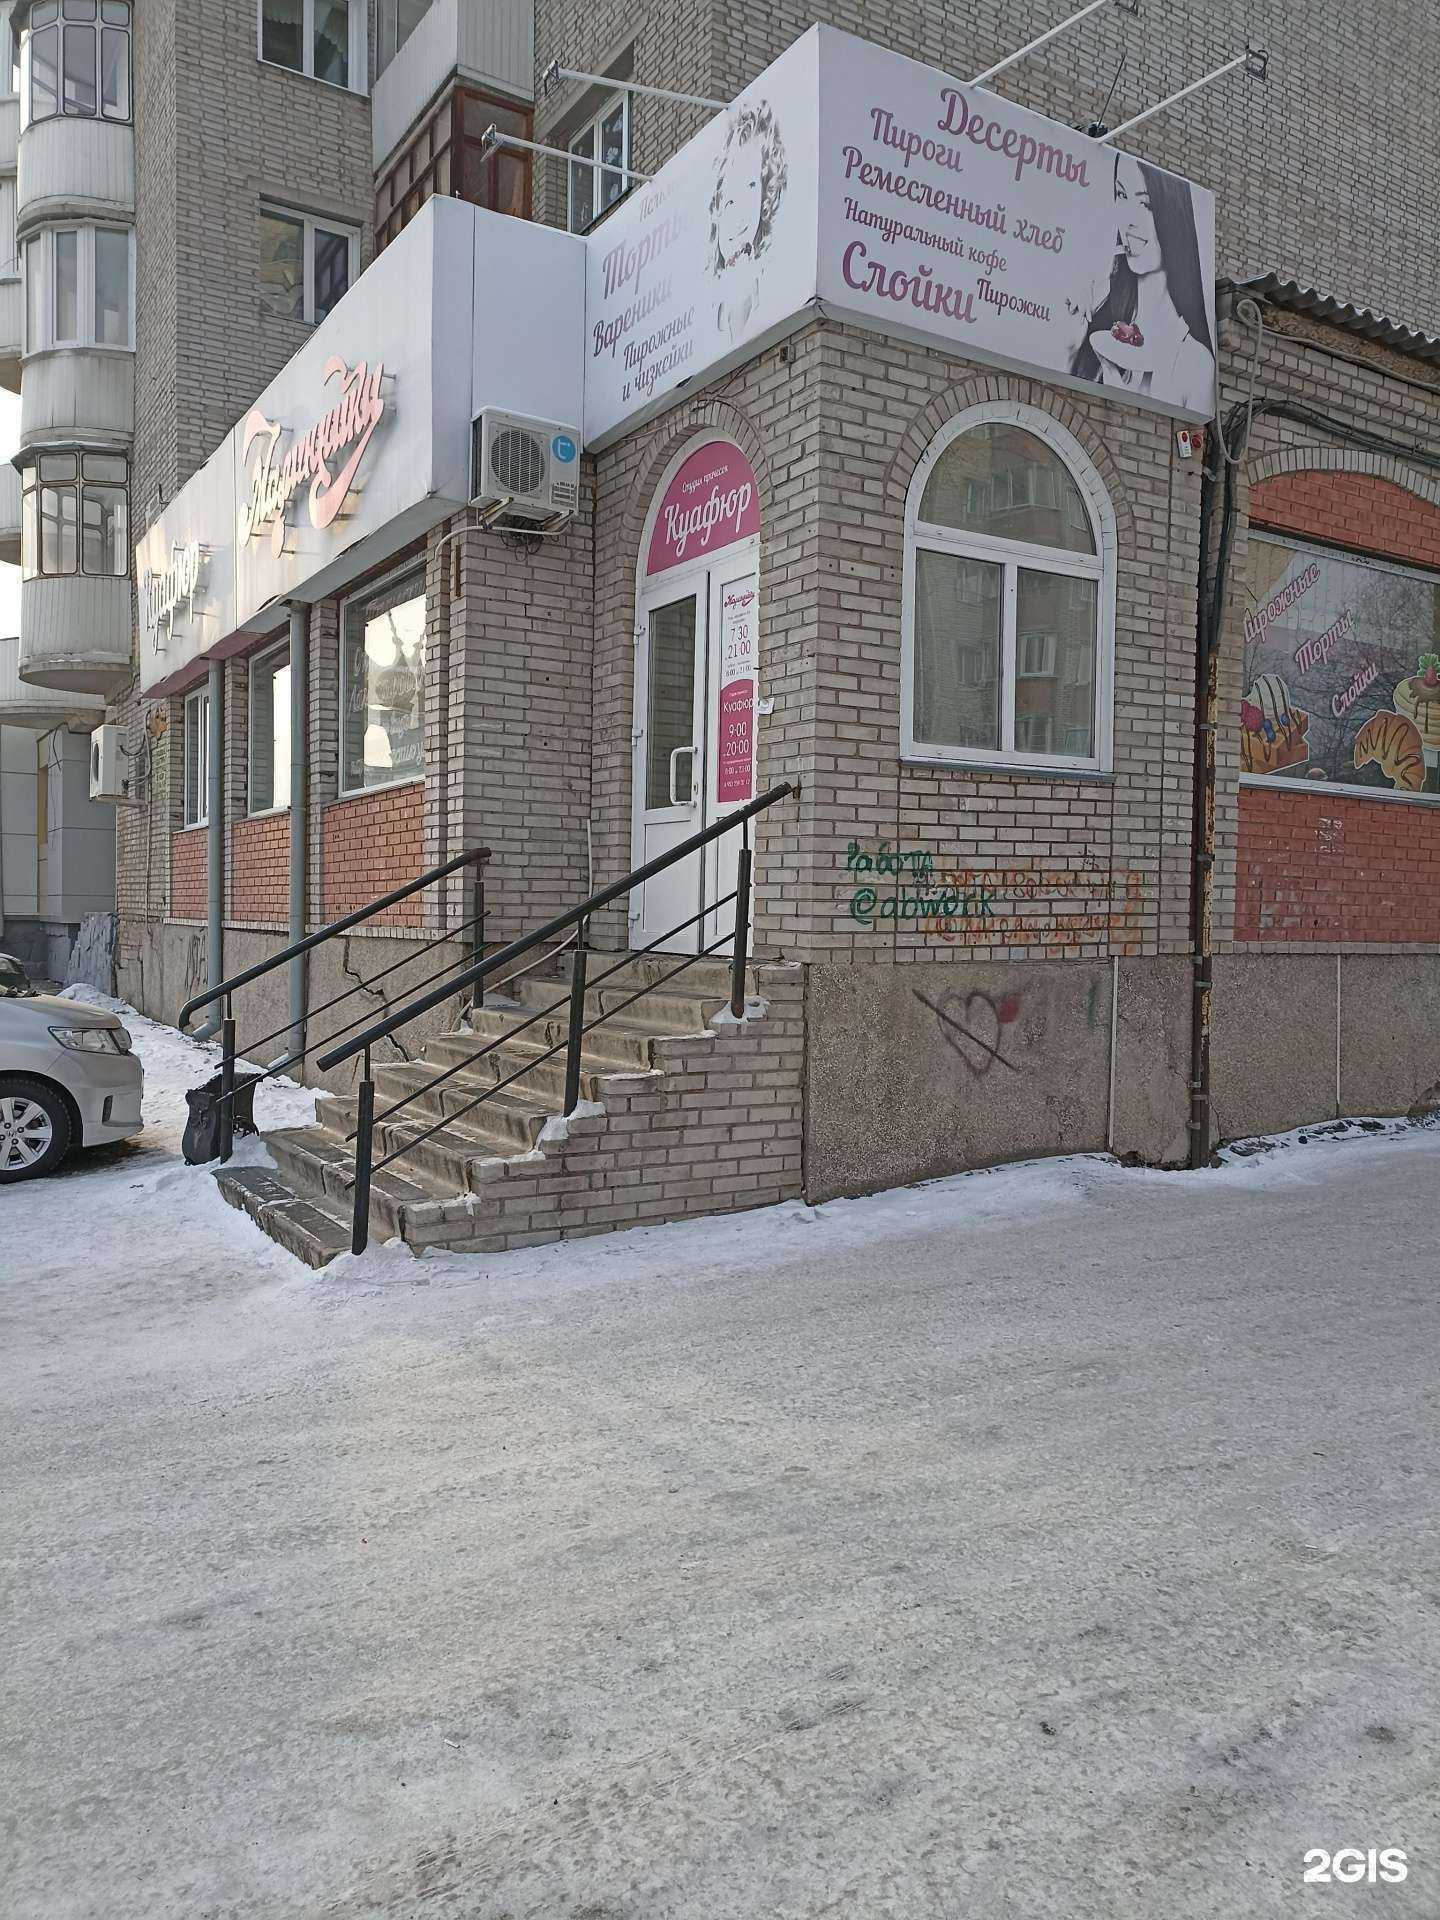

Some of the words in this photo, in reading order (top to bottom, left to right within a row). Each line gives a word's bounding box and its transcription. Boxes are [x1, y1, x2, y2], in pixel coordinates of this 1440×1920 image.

[870, 107, 963, 172] Пироги
[937, 87, 1090, 187] Десерты
[842, 146, 1007, 234] Ремесленный
[1013, 219, 1066, 253] хлеб
[844, 197, 964, 257] Натуральный
[968, 246, 1009, 275] кофе
[593, 276, 673, 359] Вареники
[842, 240, 977, 325] Слойки
[977, 278, 1052, 322] Пирожки
[622, 381, 631, 402] и
[635, 339, 693, 397] чизкейки
[624, 304, 695, 373] Пирожные
[665, 482, 751, 557] Куафюр
[1294, 608, 1353, 674] Торты
[1331, 662, 1378, 718] Слойки
